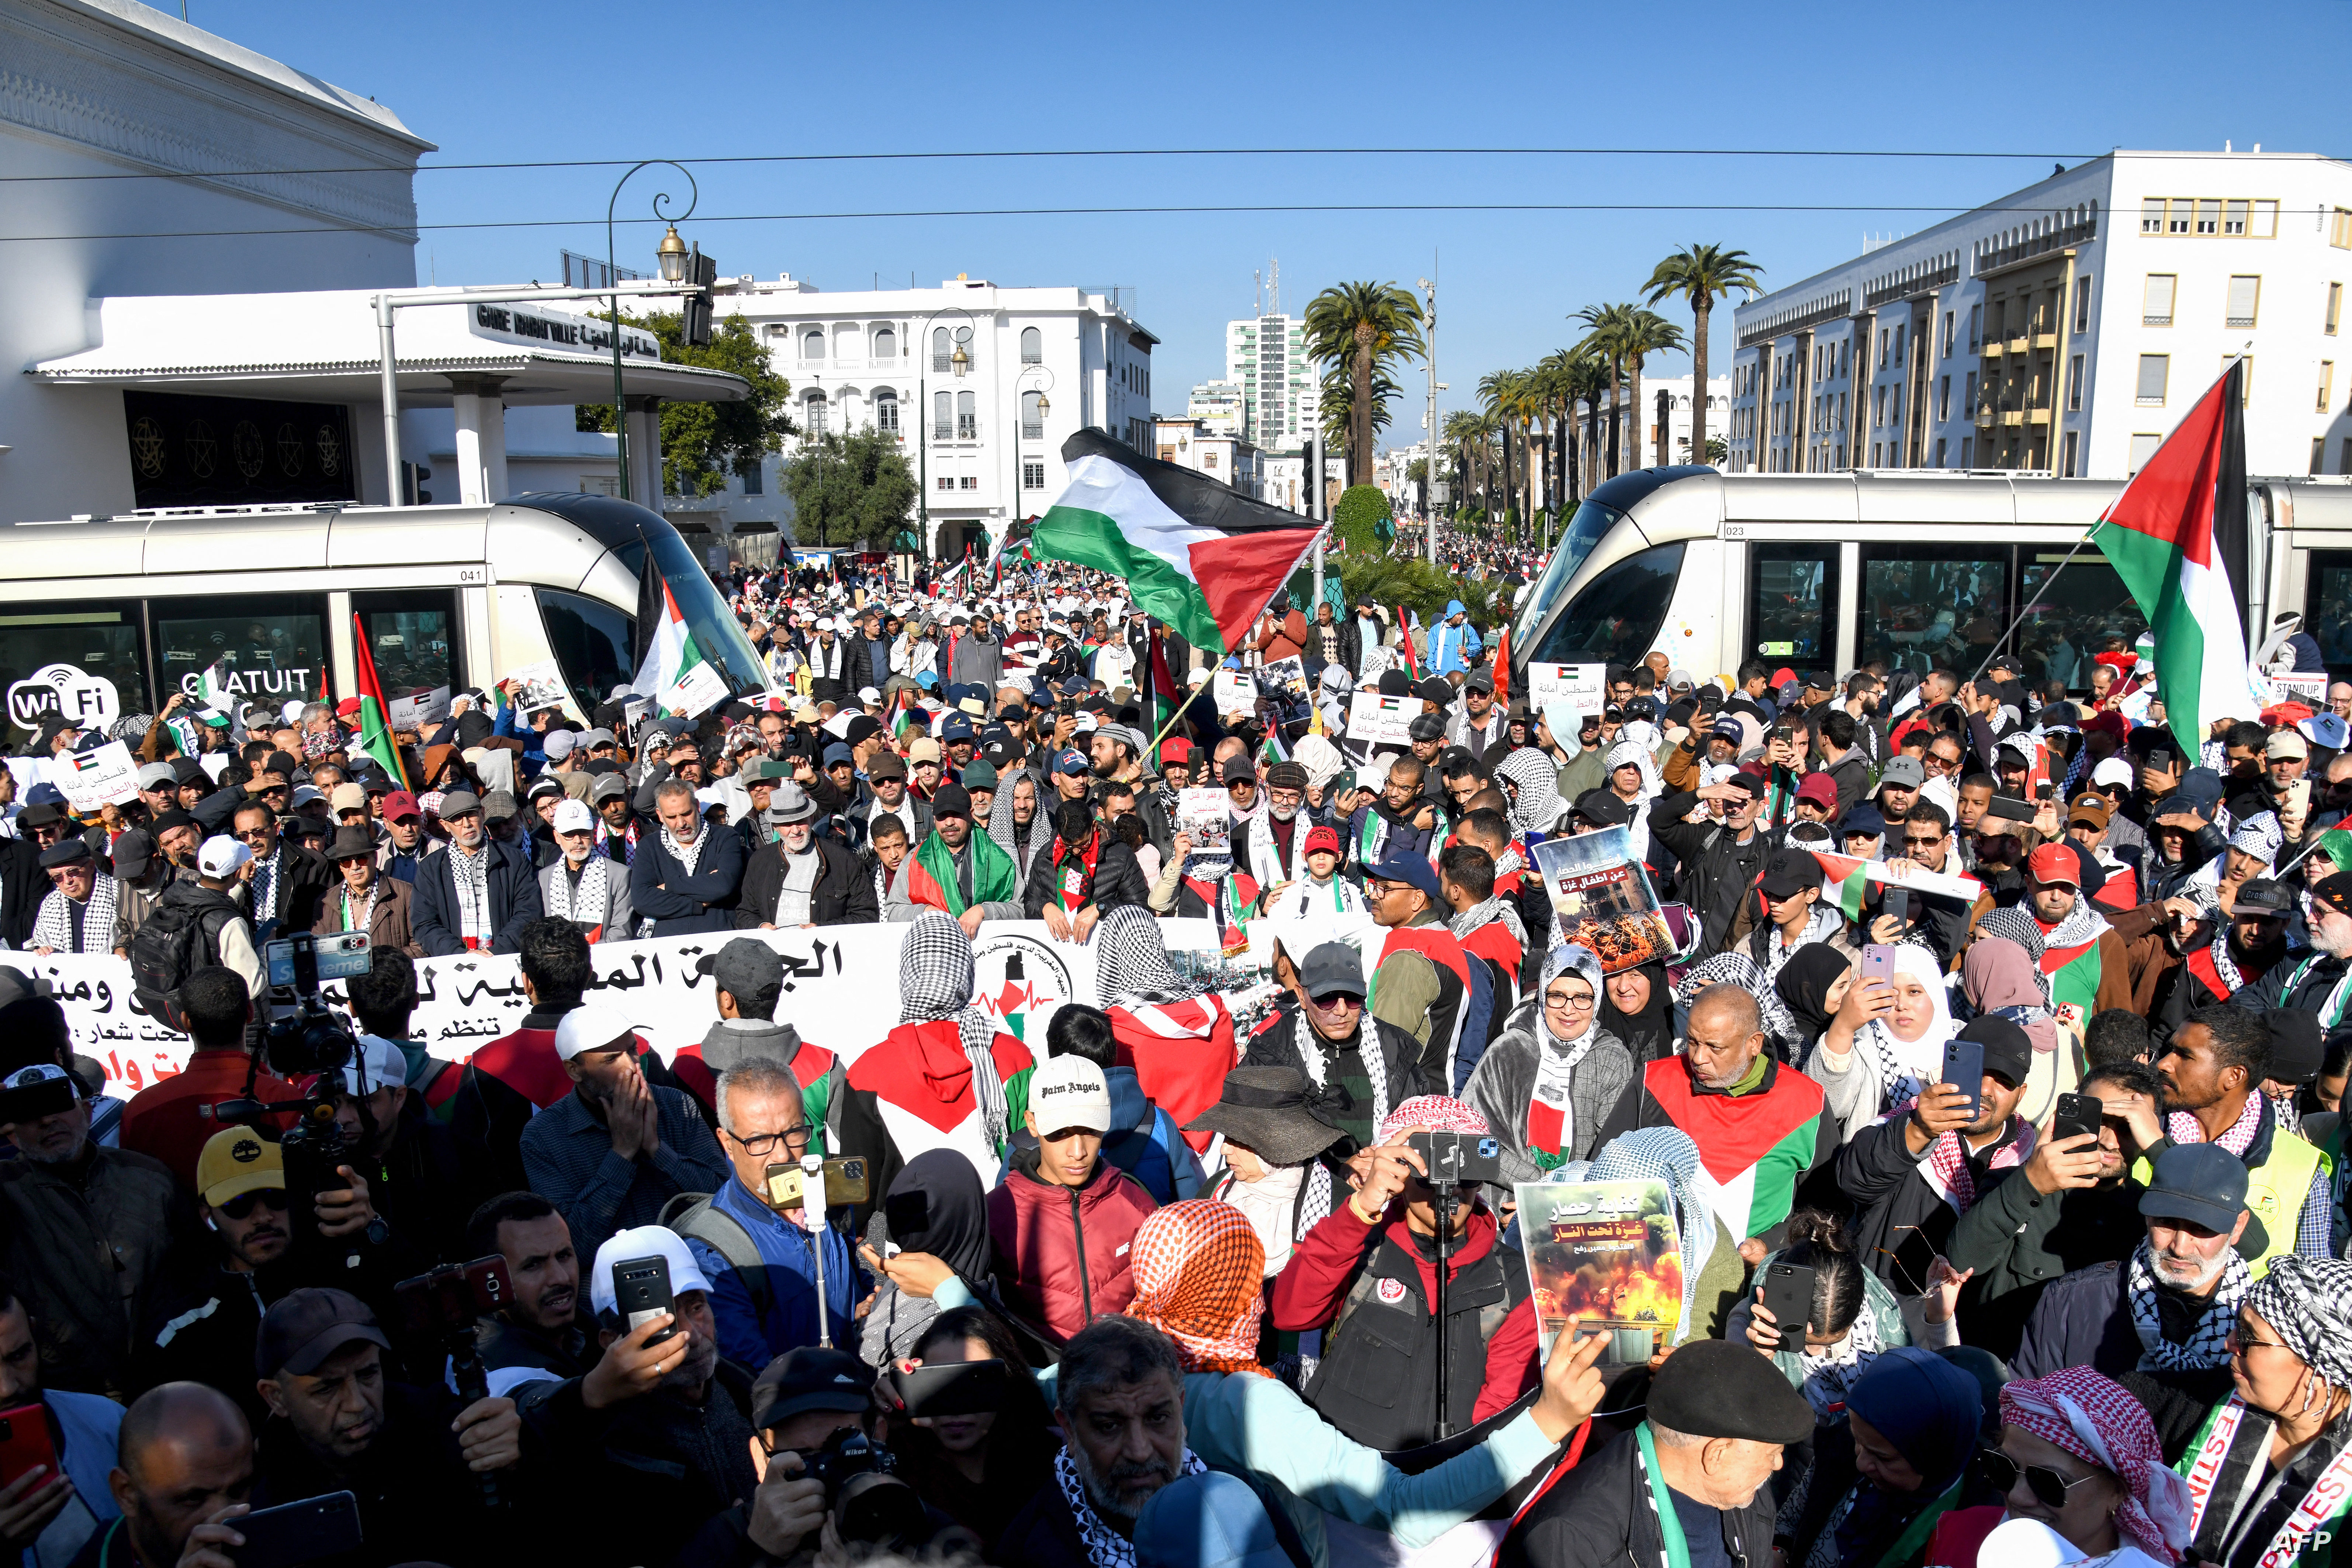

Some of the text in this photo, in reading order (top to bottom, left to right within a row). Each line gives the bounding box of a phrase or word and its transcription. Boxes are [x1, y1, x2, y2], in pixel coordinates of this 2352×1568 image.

[478, 305, 579, 345] GARE RABAT VILLE
[1726, 527, 1744, 536] 023
[461, 571, 481, 581] 041
[182, 669, 310, 697] GATUIT
[1539, 682, 1597, 696] فلسطين أمانة
[2277, 683, 2304, 694] STAND
[2307, 685, 2319, 694] UP
[699, 685, 722, 706] والتطبيع
[1220, 688, 1233, 696] أمانة
[399, 700, 445, 717] فلسطين أمانة
[1219, 701, 1232, 710] خيانة
[1359, 711, 1379, 721] أمانة
[1356, 724, 1411, 738] التطبيع خيانة
[1227, 761, 1248, 771] POLICE
[65, 765, 127, 789] فلسطين أمانة
[73, 781, 139, 804] والتطبيع خيانة
[1189, 790, 1223, 800] أوقفوا قتل
[1193, 804, 1220, 813] المدنيين
[1309, 829, 1336, 840] BROOKLYN
[1372, 823, 1385, 858] فلسطين
[1556, 854, 1622, 878] ارفعوا الحصار
[1562, 870, 1625, 891] عن اطفال غزة
[778, 895, 799, 907] CK&
[1222, 886, 1234, 920] فلسطين
[777, 907, 810, 920] JONES
[987, 941, 1013, 953] فلسطين
[1015, 944, 1035, 953] لدعم
[1035, 949, 1059, 973] المغربية
[279, 959, 365, 981] Sreme
[1056, 973, 1067, 996] الجبهة
[87, 1022, 134, 1043] شعار
[437, 1018, 501, 1042] تنظم
[1041, 1081, 1101, 1098] Palm Angels
[1548, 1194, 1638, 1222] كفاية حصار
[1553, 1220, 1643, 1243] غزة تحت النار
